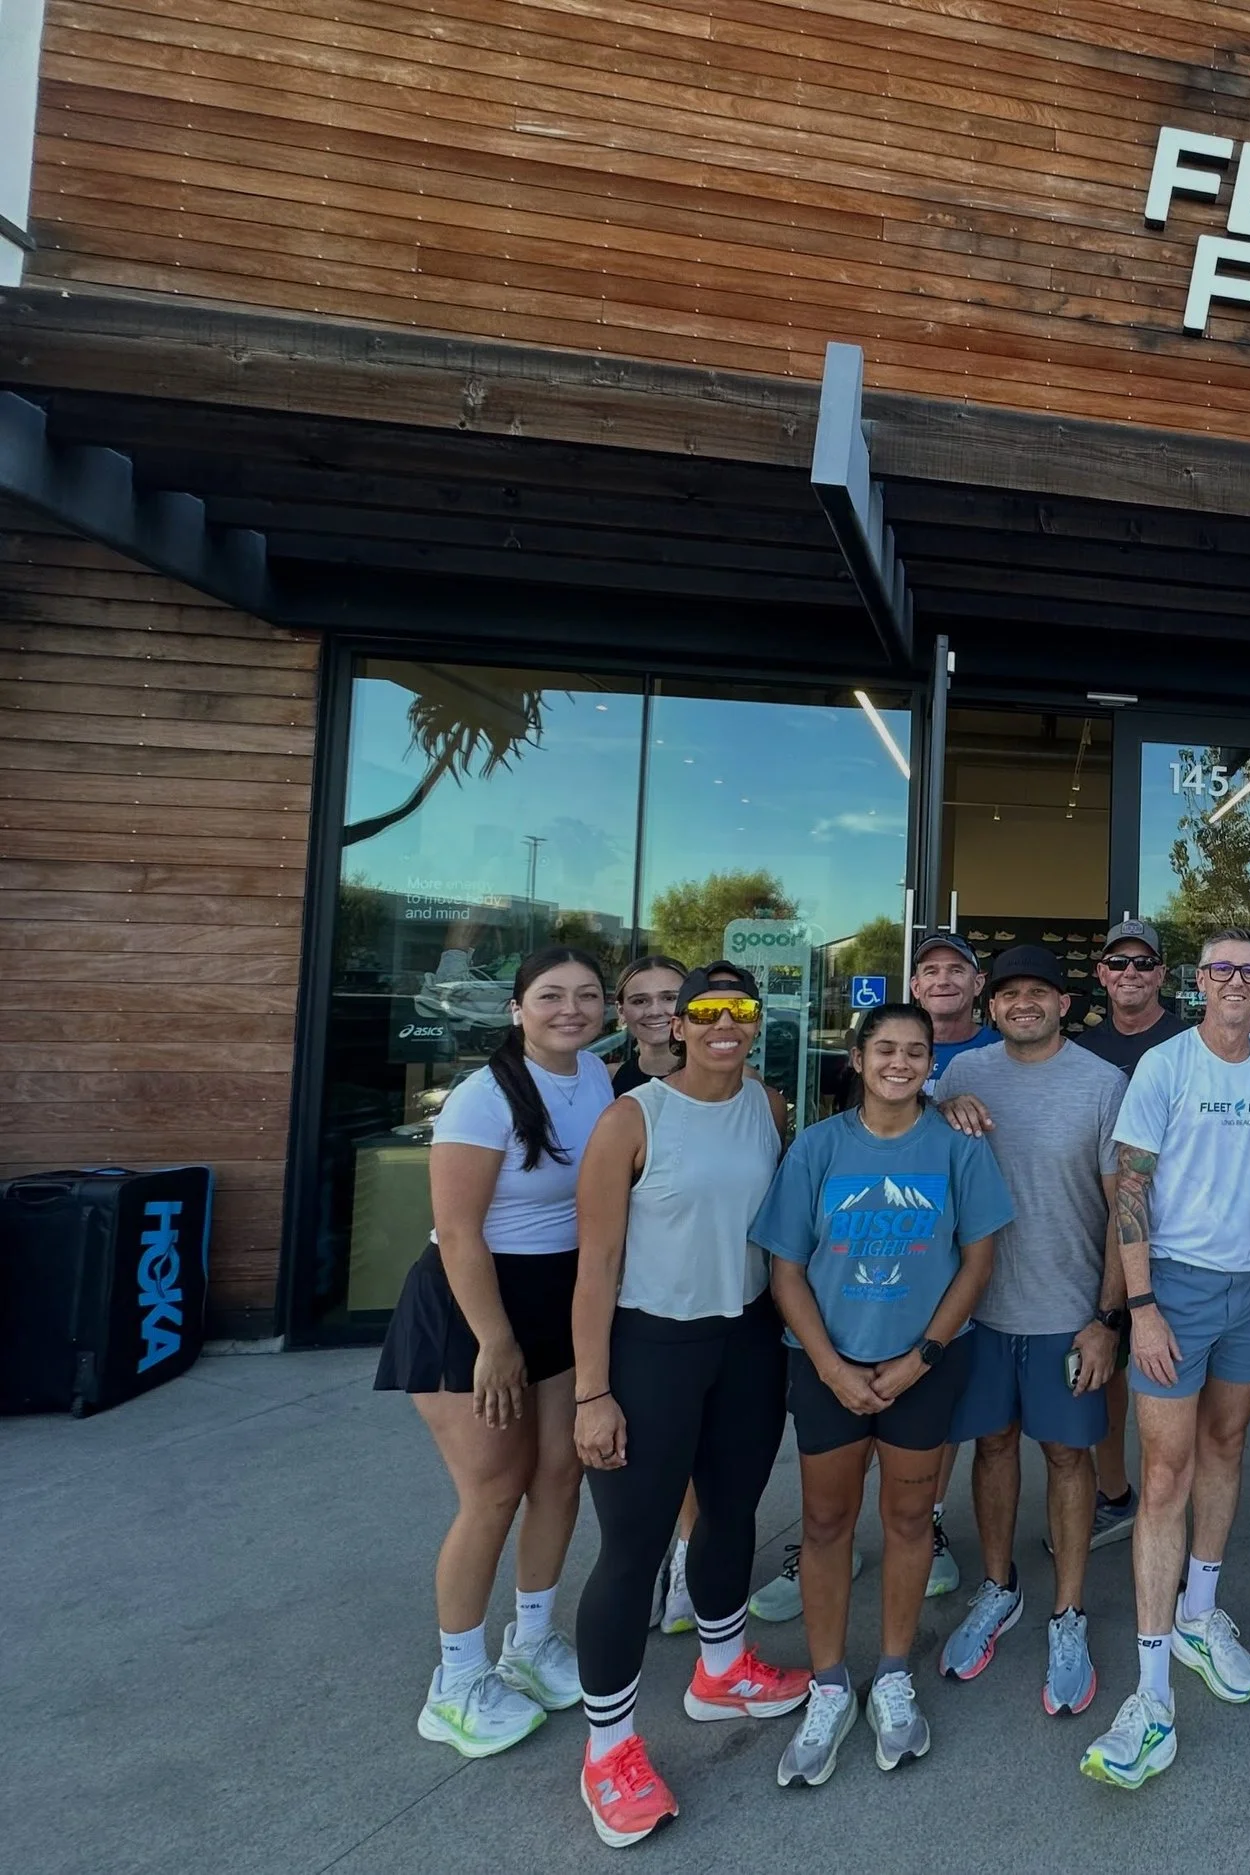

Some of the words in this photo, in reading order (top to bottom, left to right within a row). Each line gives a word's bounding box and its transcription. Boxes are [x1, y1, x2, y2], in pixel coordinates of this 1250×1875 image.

[1169, 762, 1229, 797] 145
[406, 894, 421, 904] to
[405, 907, 432, 919] and
[435, 908, 470, 920] mind
[413, 1026, 444, 1036] asics
[1200, 1102, 1231, 1112] FLEET
[831, 1211, 936, 1240] BUSCH
[848, 1239, 913, 1258] LIGHT
[137, 1201, 183, 1374] HOKA
